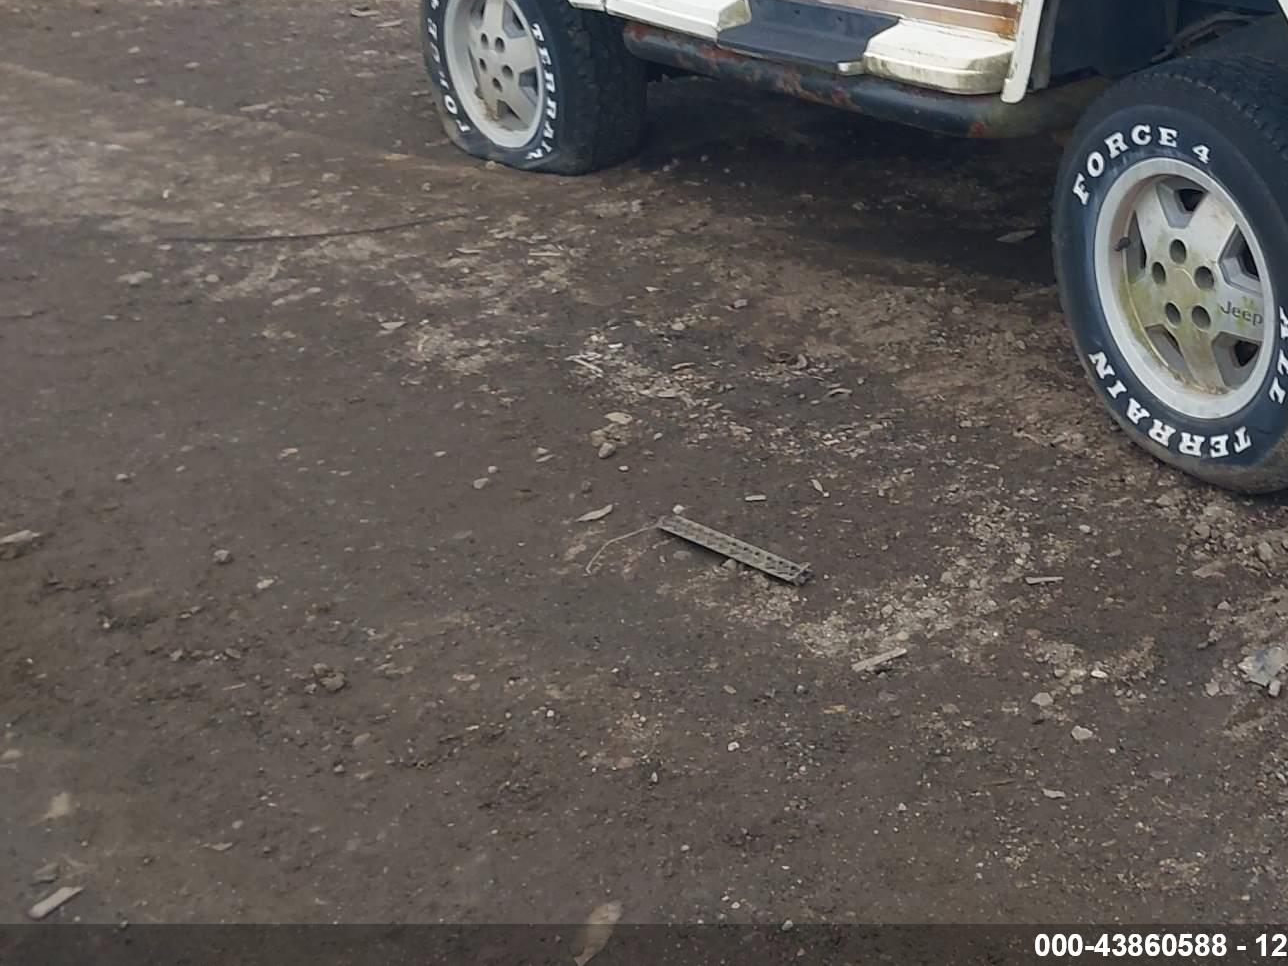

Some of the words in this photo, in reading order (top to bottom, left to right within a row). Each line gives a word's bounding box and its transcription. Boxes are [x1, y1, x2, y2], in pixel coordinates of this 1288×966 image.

[1072, 124, 1179, 205] FORCE
[1192, 143, 1211, 164] 4
[1220, 301, 1264, 326] Jeep
[1088, 350, 1252, 458] TERRAIN
